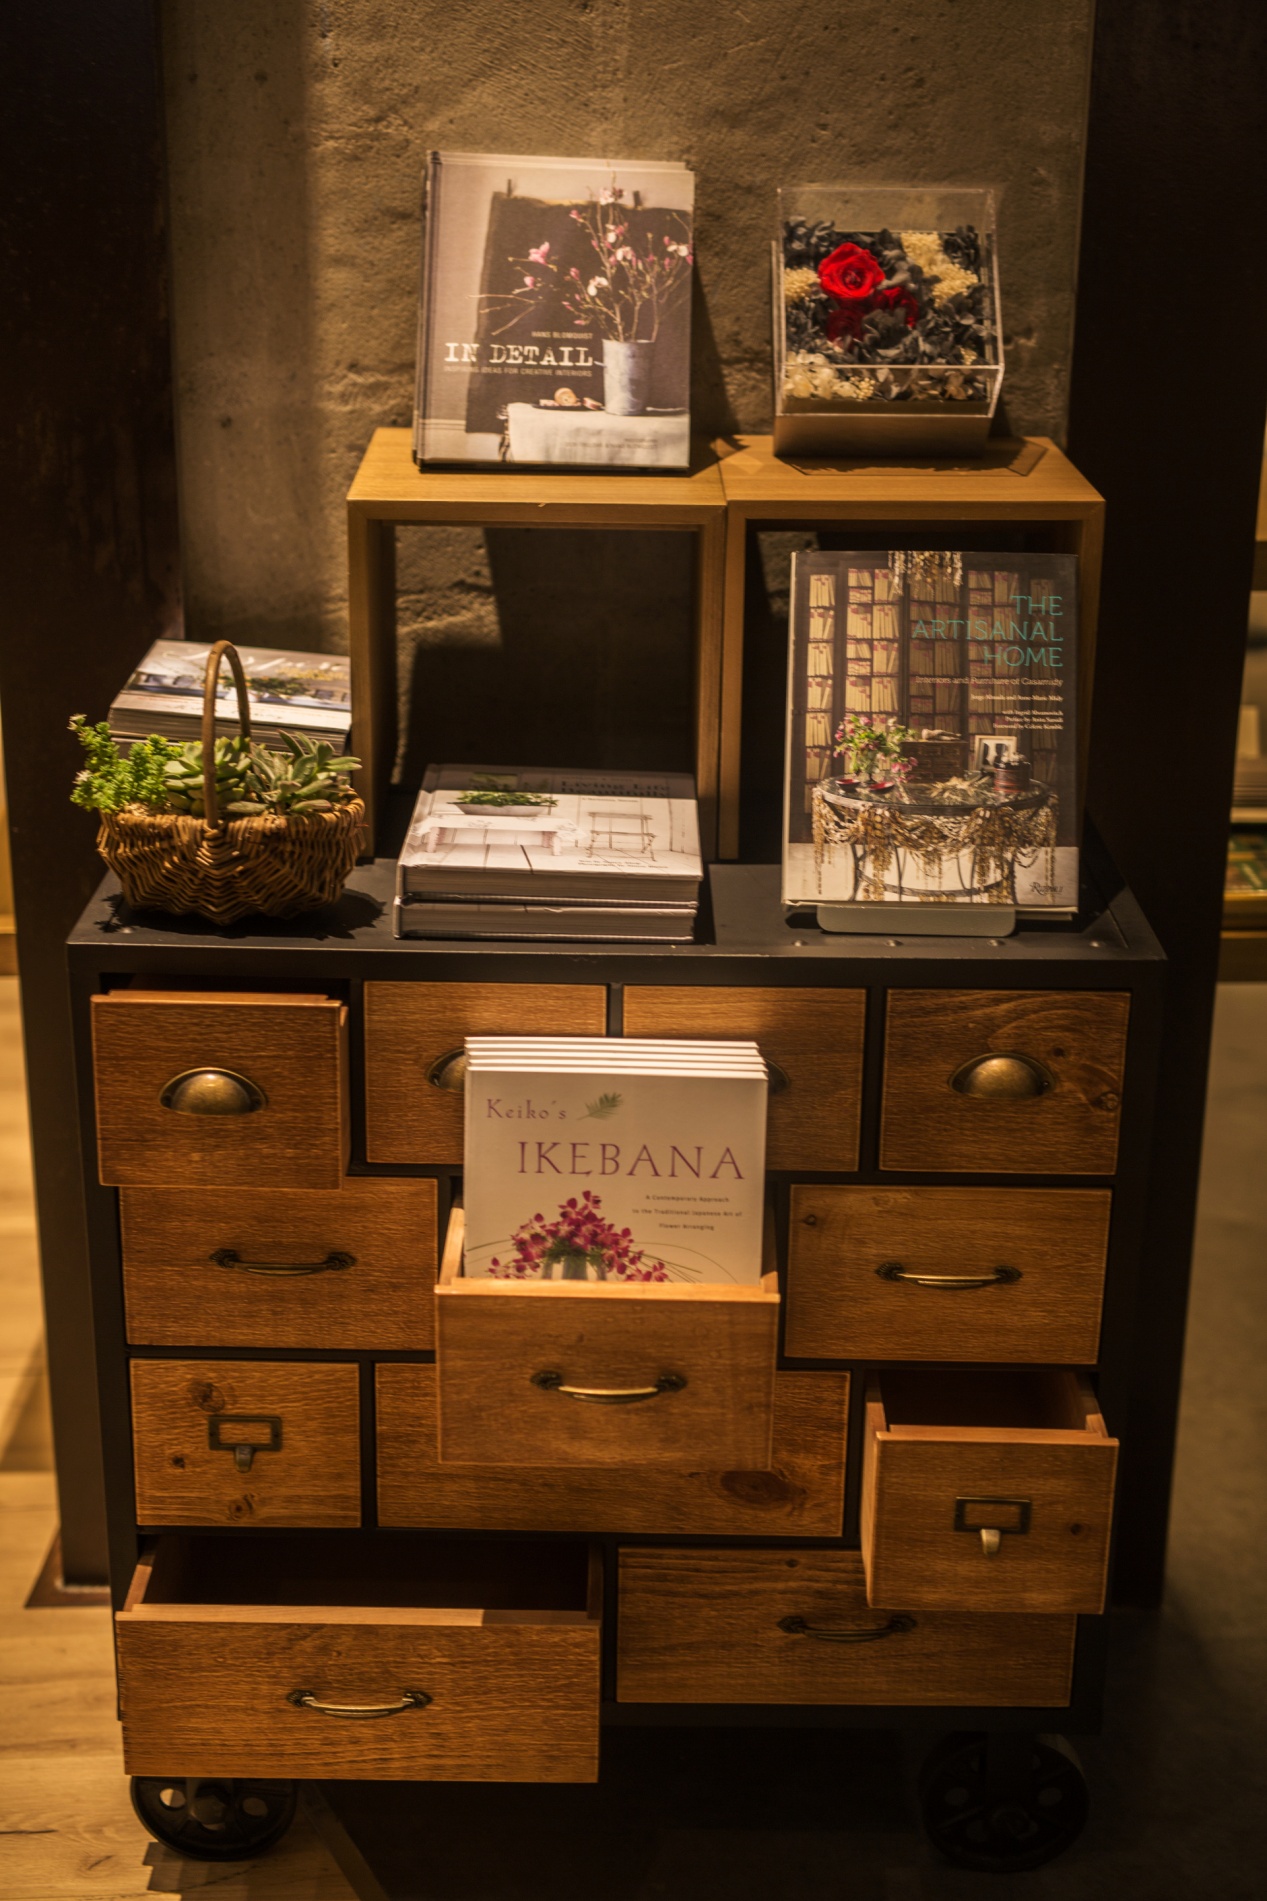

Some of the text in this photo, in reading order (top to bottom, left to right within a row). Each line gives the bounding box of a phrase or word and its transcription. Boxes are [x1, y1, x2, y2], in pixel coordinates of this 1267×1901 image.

[444, 342, 593, 367] IN DETAIL
[504, 367, 519, 375] FOR
[520, 368, 554, 376] CREATIVE
[555, 369, 593, 377] INTERIORS
[1010, 595, 1063, 616] THE
[911, 620, 1063, 641] ARTISANAL
[983, 646, 1063, 667] HOME
[486, 1098, 567, 1120] Keiko's
[517, 1141, 745, 1180] IKEBANA
[652, 1194, 697, 1202] Contemporary
[654, 1208, 690, 1216] Traditional
